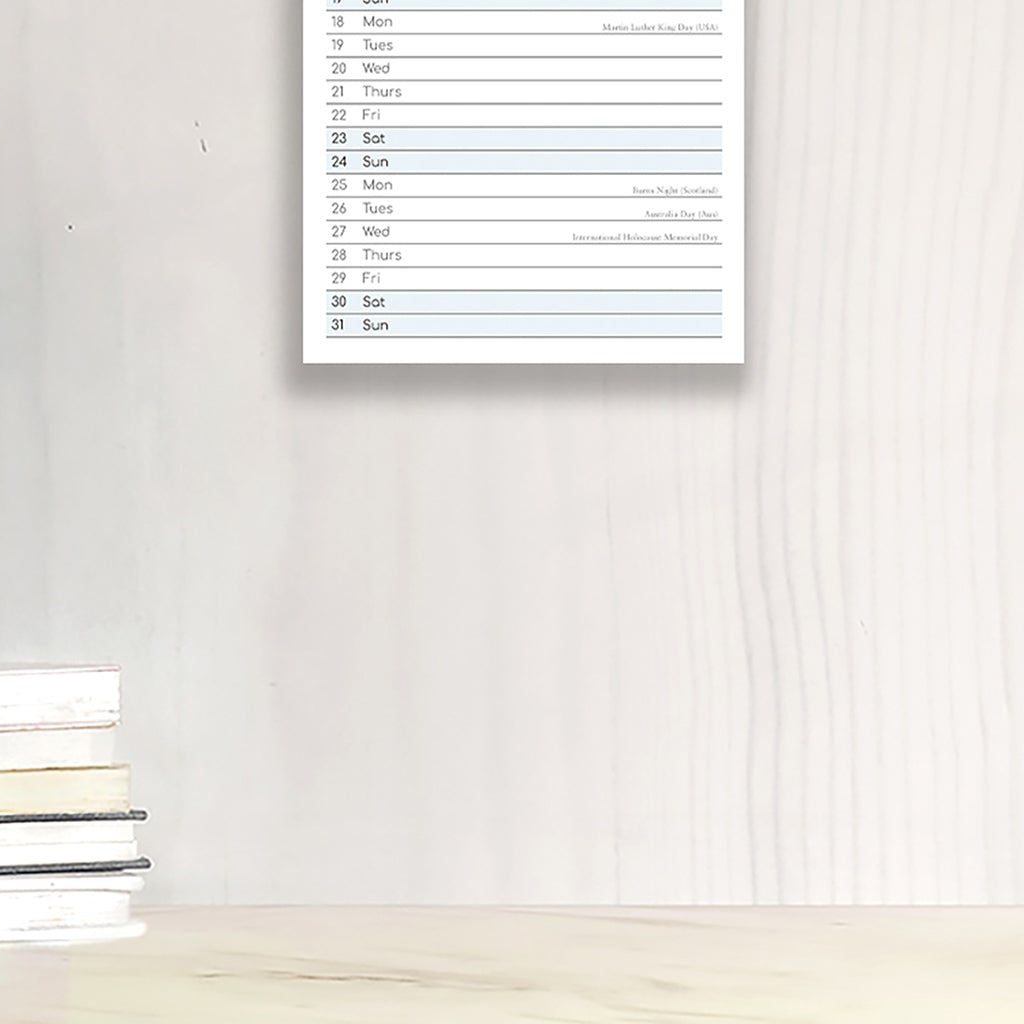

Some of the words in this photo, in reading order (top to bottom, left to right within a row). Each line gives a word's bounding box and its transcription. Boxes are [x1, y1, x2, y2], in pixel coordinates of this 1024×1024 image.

[331, 16, 345, 27] 18
[362, 16, 393, 27] Mon
[601, 23, 630, 31] Martin
[657, 23, 677, 33] King
[677, 23, 694, 33] Day
[331, 39, 345, 50] 19
[362, 39, 394, 51] Tues
[331, 62, 347, 74] 20
[361, 63, 391, 74] Wed
[331, 85, 344, 97] 21
[362, 85, 403, 97] Thurs
[331, 109, 347, 121] 22
[361, 109, 381, 120] Fri
[331, 132, 348, 144] 23
[362, 132, 386, 144] Sat
[331, 155, 348, 168] 24
[362, 155, 389, 168] Sun
[331, 179, 348, 190] 25
[362, 179, 393, 190] Mon
[331, 202, 347, 214] 26
[362, 202, 394, 214] Tues
[680, 209, 696, 219] Day
[331, 225, 347, 237] 27
[361, 226, 391, 237] Wed
[702, 233, 719, 243] Day
[331, 249, 347, 261] 28
[362, 248, 403, 261] Thurs
[331, 272, 347, 284] 29
[361, 272, 381, 283] Fri
[330, 295, 347, 307] 30
[362, 295, 386, 307] Sat
[330, 318, 344, 330] 31
[362, 319, 389, 331] Sun
